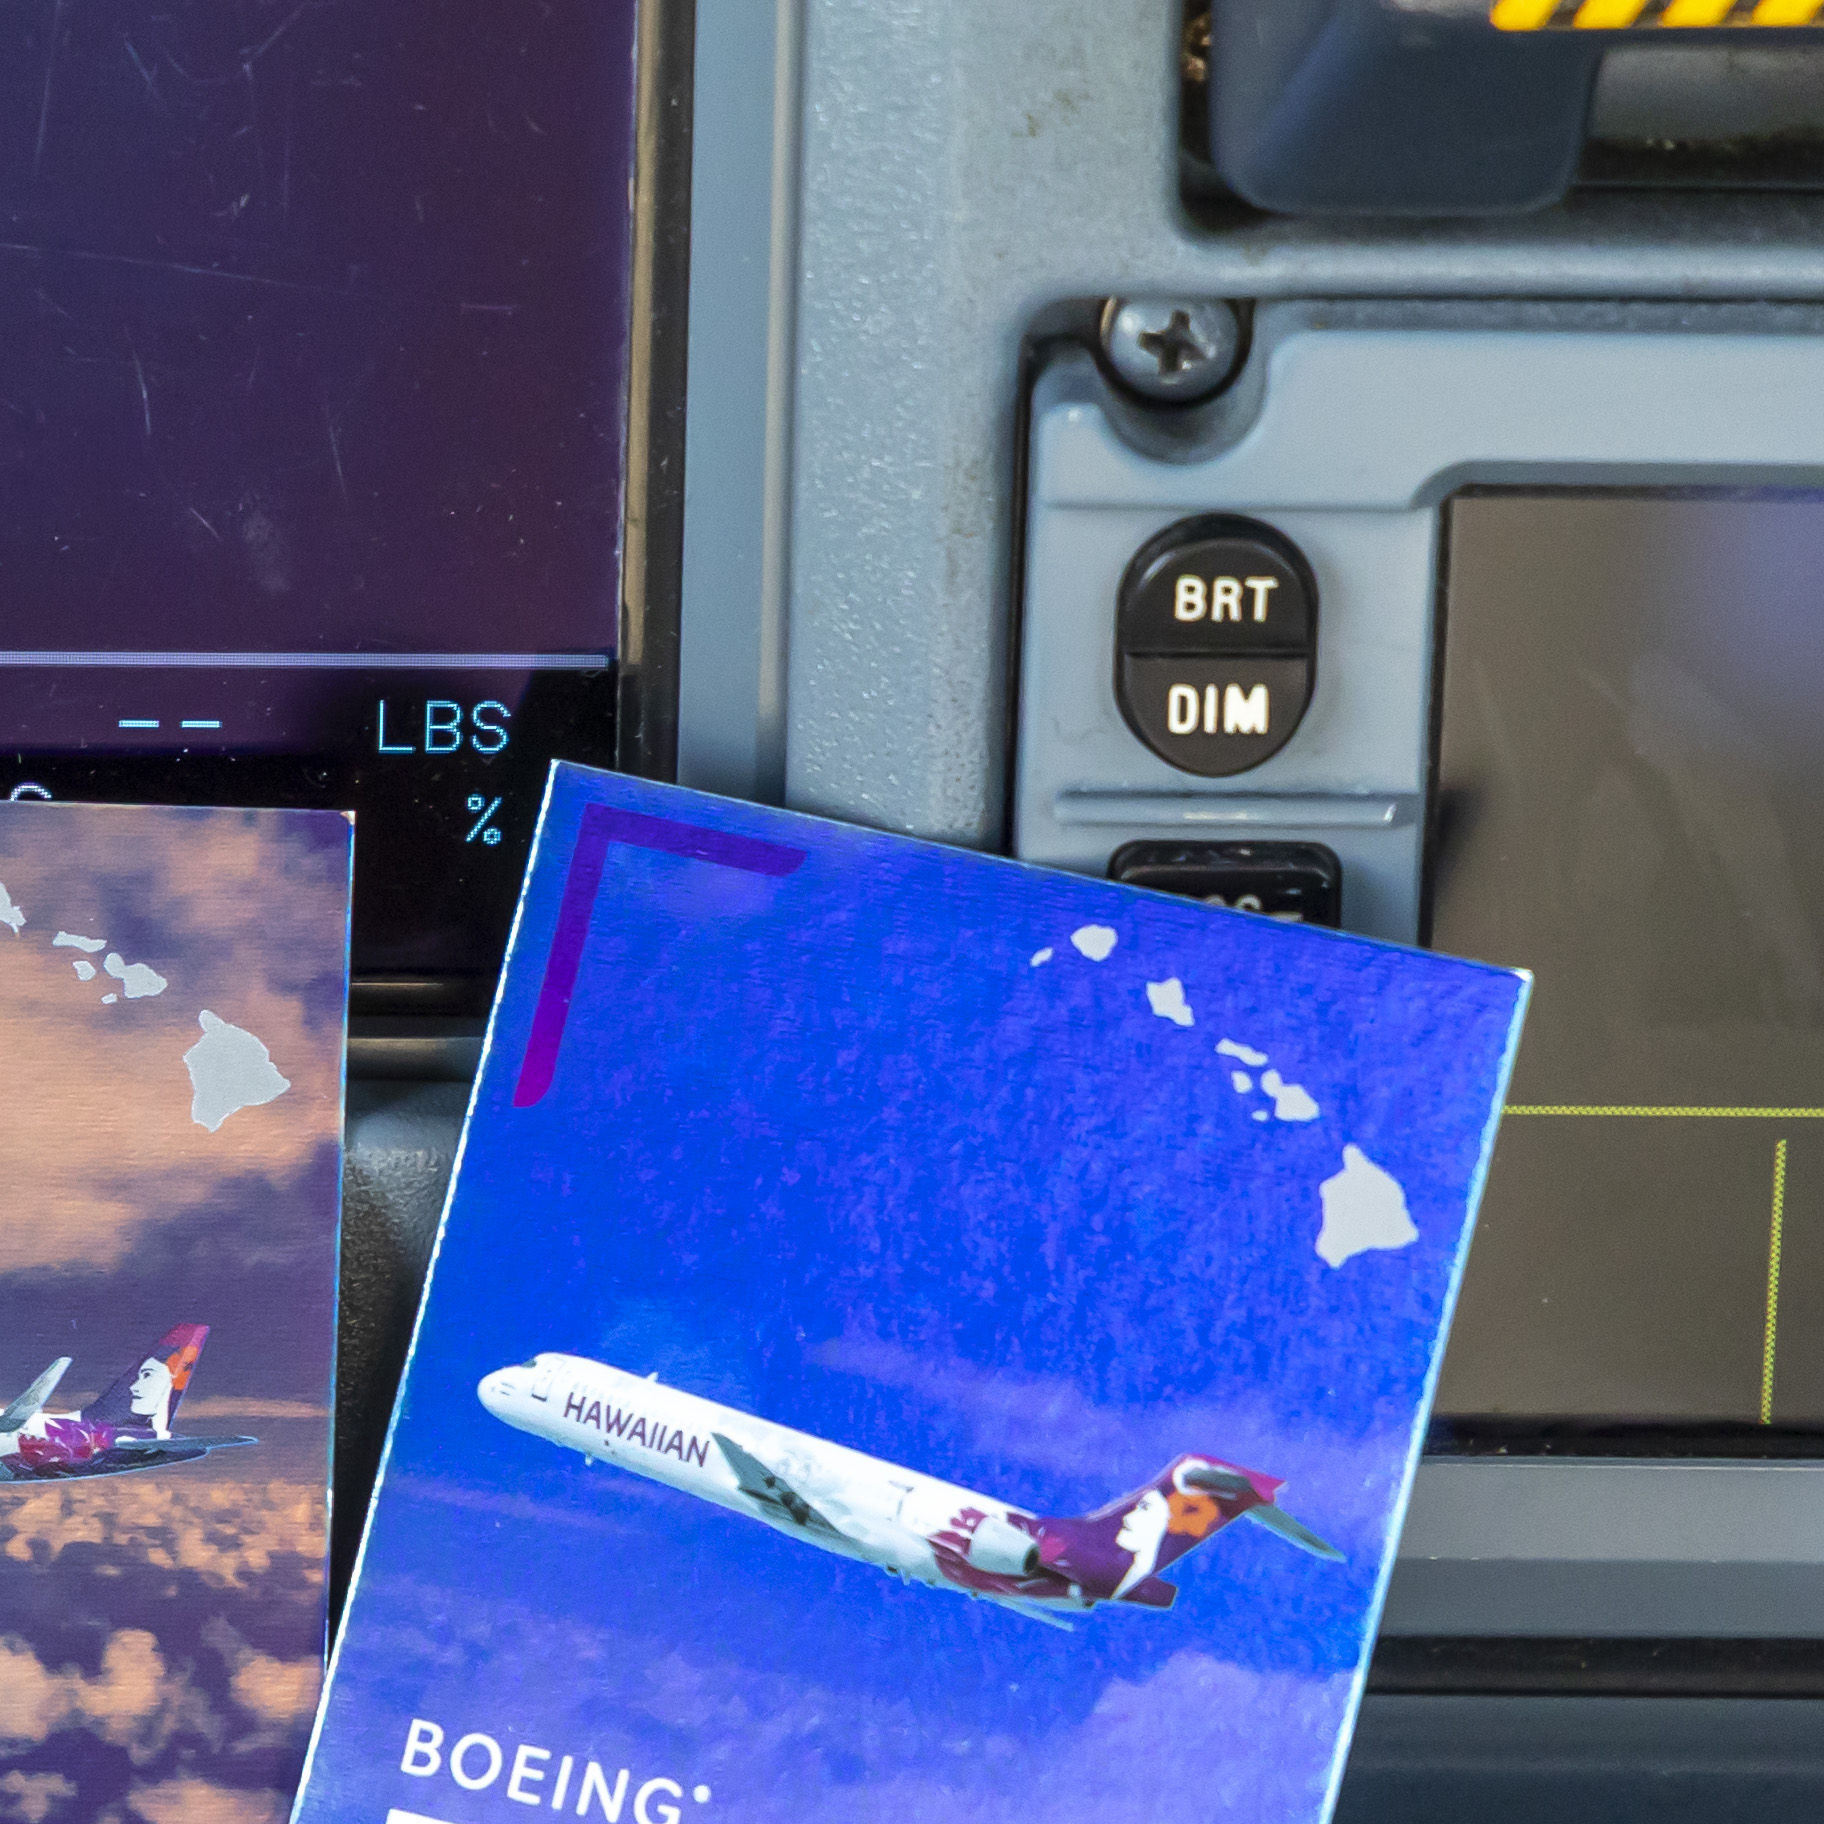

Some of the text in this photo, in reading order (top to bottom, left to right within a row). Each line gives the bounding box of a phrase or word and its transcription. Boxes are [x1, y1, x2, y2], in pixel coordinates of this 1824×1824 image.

[1173, 575, 1278, 623] BRT
[377, 698, 512, 754] LBS
[1167, 683, 1270, 735] DIM
[563, 1391, 710, 1468] HAWAIIAN
